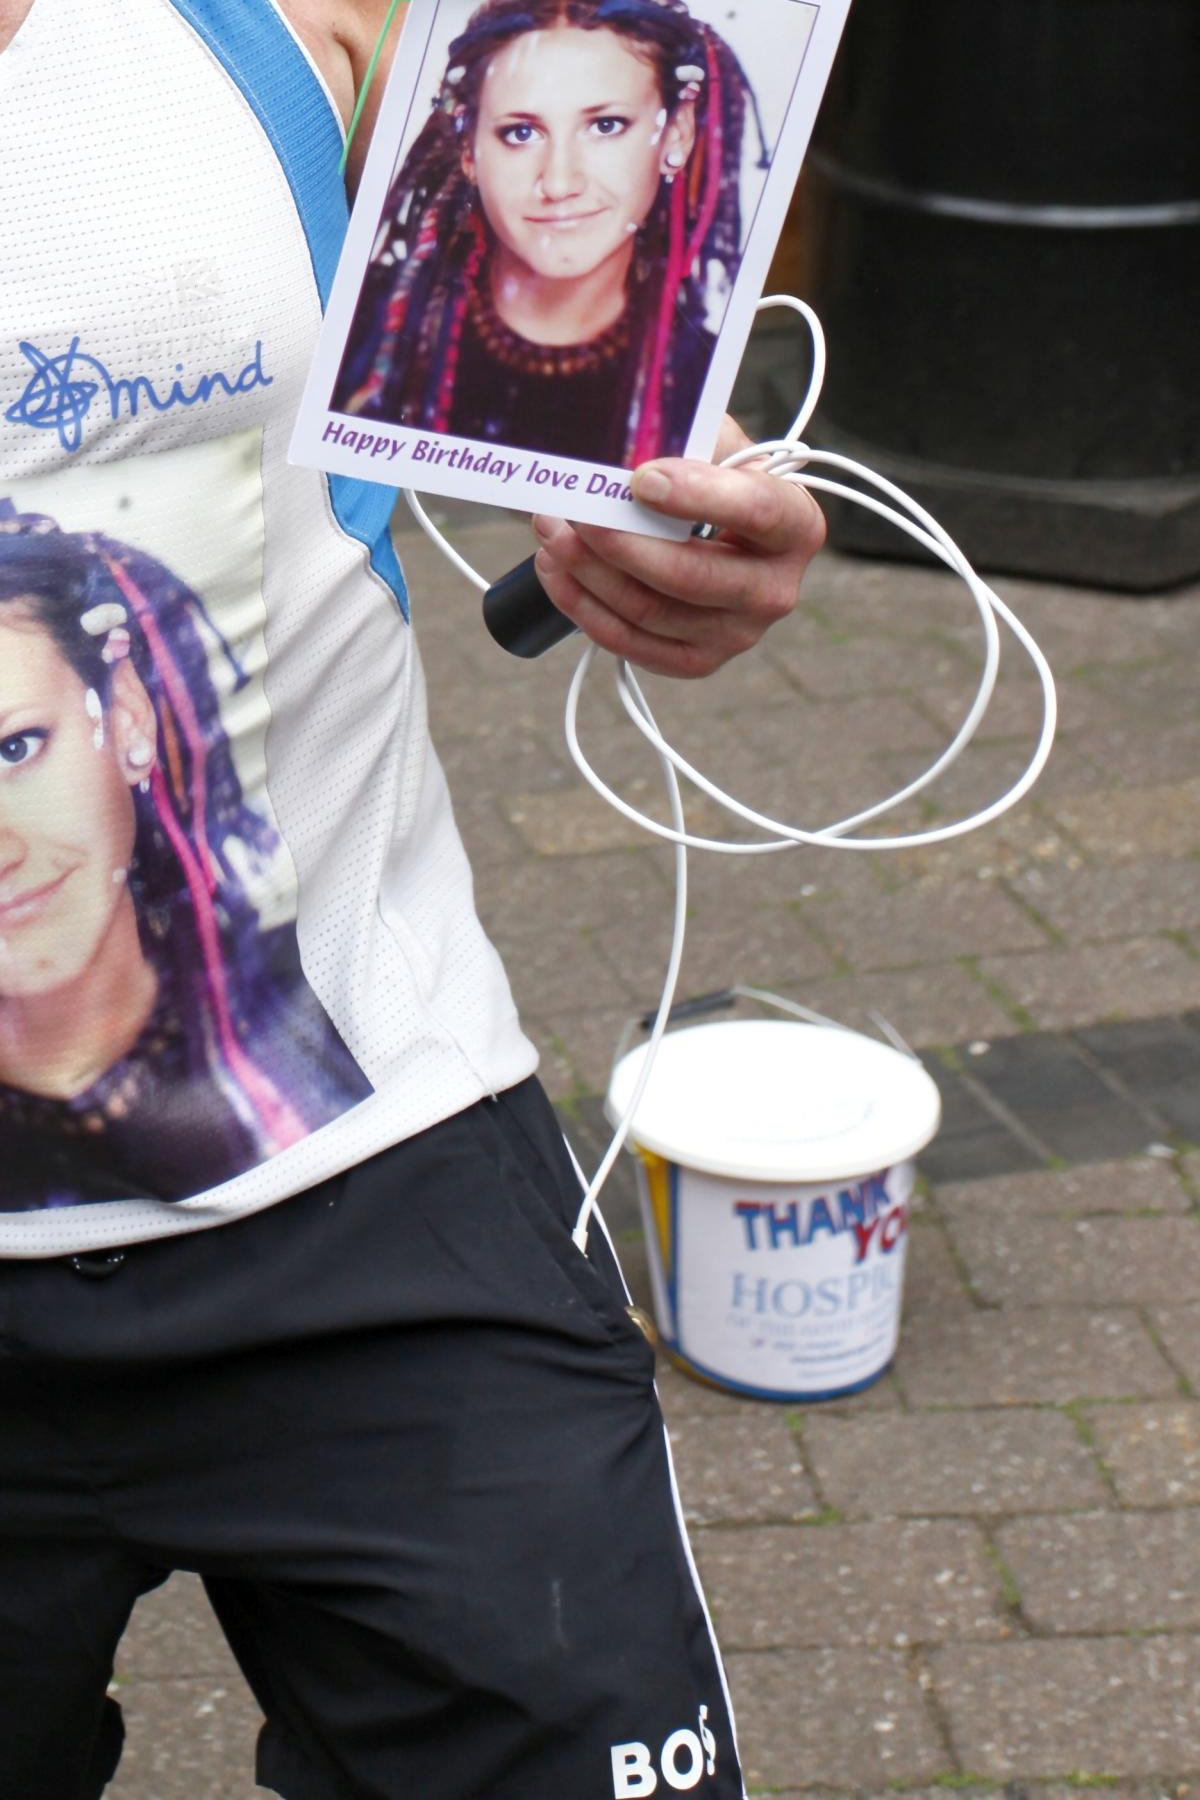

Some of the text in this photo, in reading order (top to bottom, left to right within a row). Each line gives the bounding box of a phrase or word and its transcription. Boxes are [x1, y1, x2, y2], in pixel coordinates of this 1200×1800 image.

[106, 339, 274, 420] mind
[321, 421, 407, 461] Happy
[411, 439, 522, 484] Birthday
[525, 460, 579, 490] love
[733, 1167, 892, 1250] THANK
